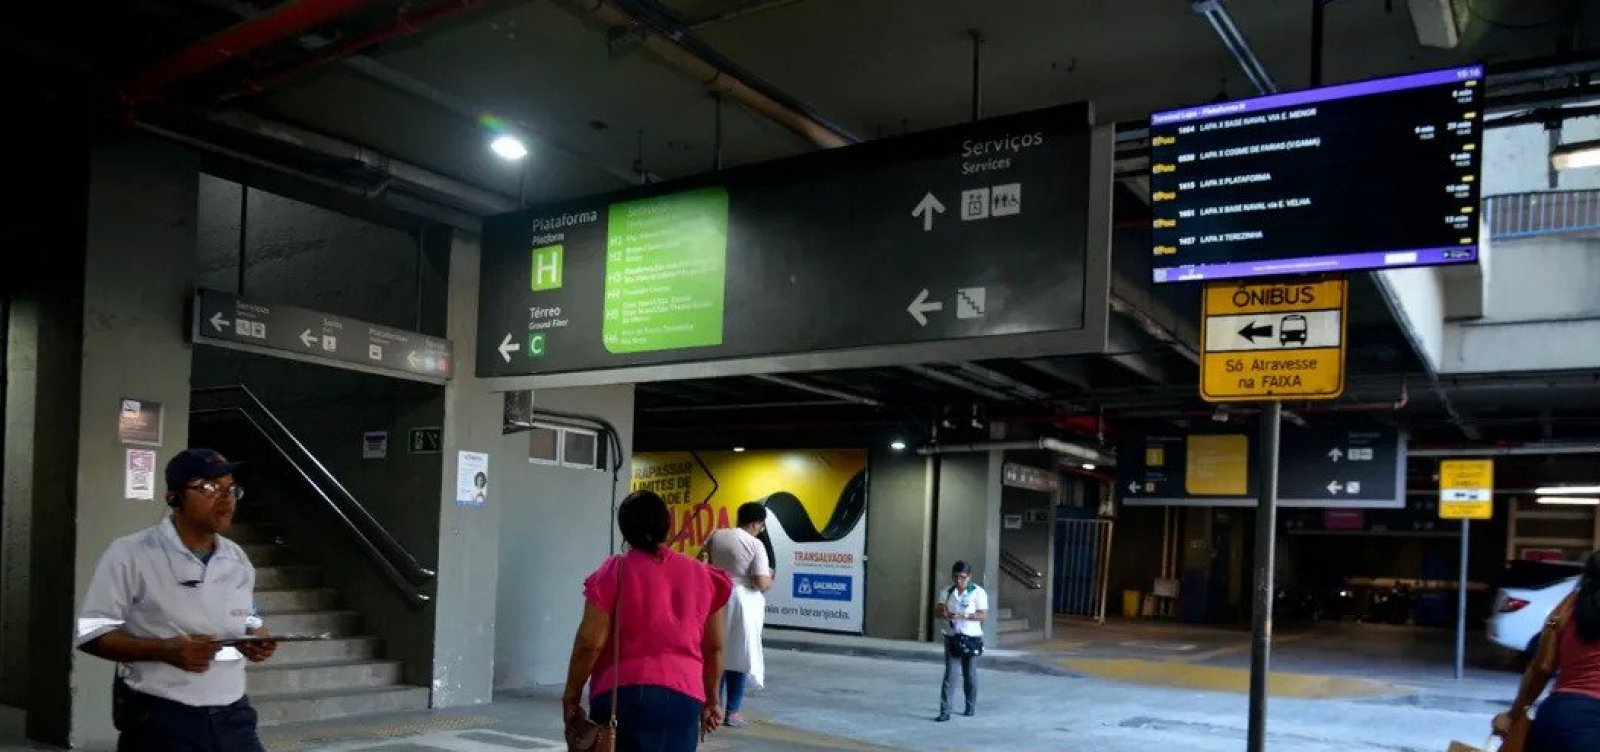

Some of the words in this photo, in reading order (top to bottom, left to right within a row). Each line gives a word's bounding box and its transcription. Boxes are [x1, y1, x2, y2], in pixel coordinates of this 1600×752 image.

[1203, 104, 1240, 115] Plataforma
[1200, 122, 1218, 131] LAPA
[1224, 118, 1242, 128] BASE
[1243, 116, 1267, 125] NAVAL
[1289, 108, 1317, 118] MENOR
[962, 131, 1044, 157] Serviços
[1200, 151, 1218, 160] LAPA
[1224, 146, 1249, 156] COSME
[1250, 144, 1260, 153] DE
[1260, 141, 1285, 152] FARIAS
[962, 157, 1011, 175] Services
[1200, 179, 1218, 188] LAPA
[1224, 173, 1271, 185] PLATAFORMA
[1200, 207, 1219, 216] LAPA
[1224, 204, 1242, 213] BASE
[1243, 202, 1267, 211] NAVAL
[1286, 197, 1311, 207] VELHA
[532, 209, 598, 232] Plataforma
[532, 231, 565, 245] Platform
[1200, 234, 1219, 243] LAPA
[1225, 230, 1264, 241] TEREZINHA
[536, 251, 558, 285] H
[1232, 285, 1315, 308] ÔNIBUS
[529, 304, 562, 319] Térreo
[528, 321, 551, 331] Ground
[552, 318, 569, 329] Floor
[531, 336, 542, 353] C
[1226, 358, 1244, 372] Só
[1252, 358, 1318, 371] Atravesse
[1239, 378, 1254, 389] na
[1262, 375, 1303, 388] FAIXA
[633, 480, 674, 492] LIMITES
[677, 478, 692, 489] DE
[794, 551, 854, 564] TRANSALVADOR
[812, 580, 847, 591] SALVADOR
[780, 606, 798, 616] em
[800, 606, 851, 620] laranjada.
